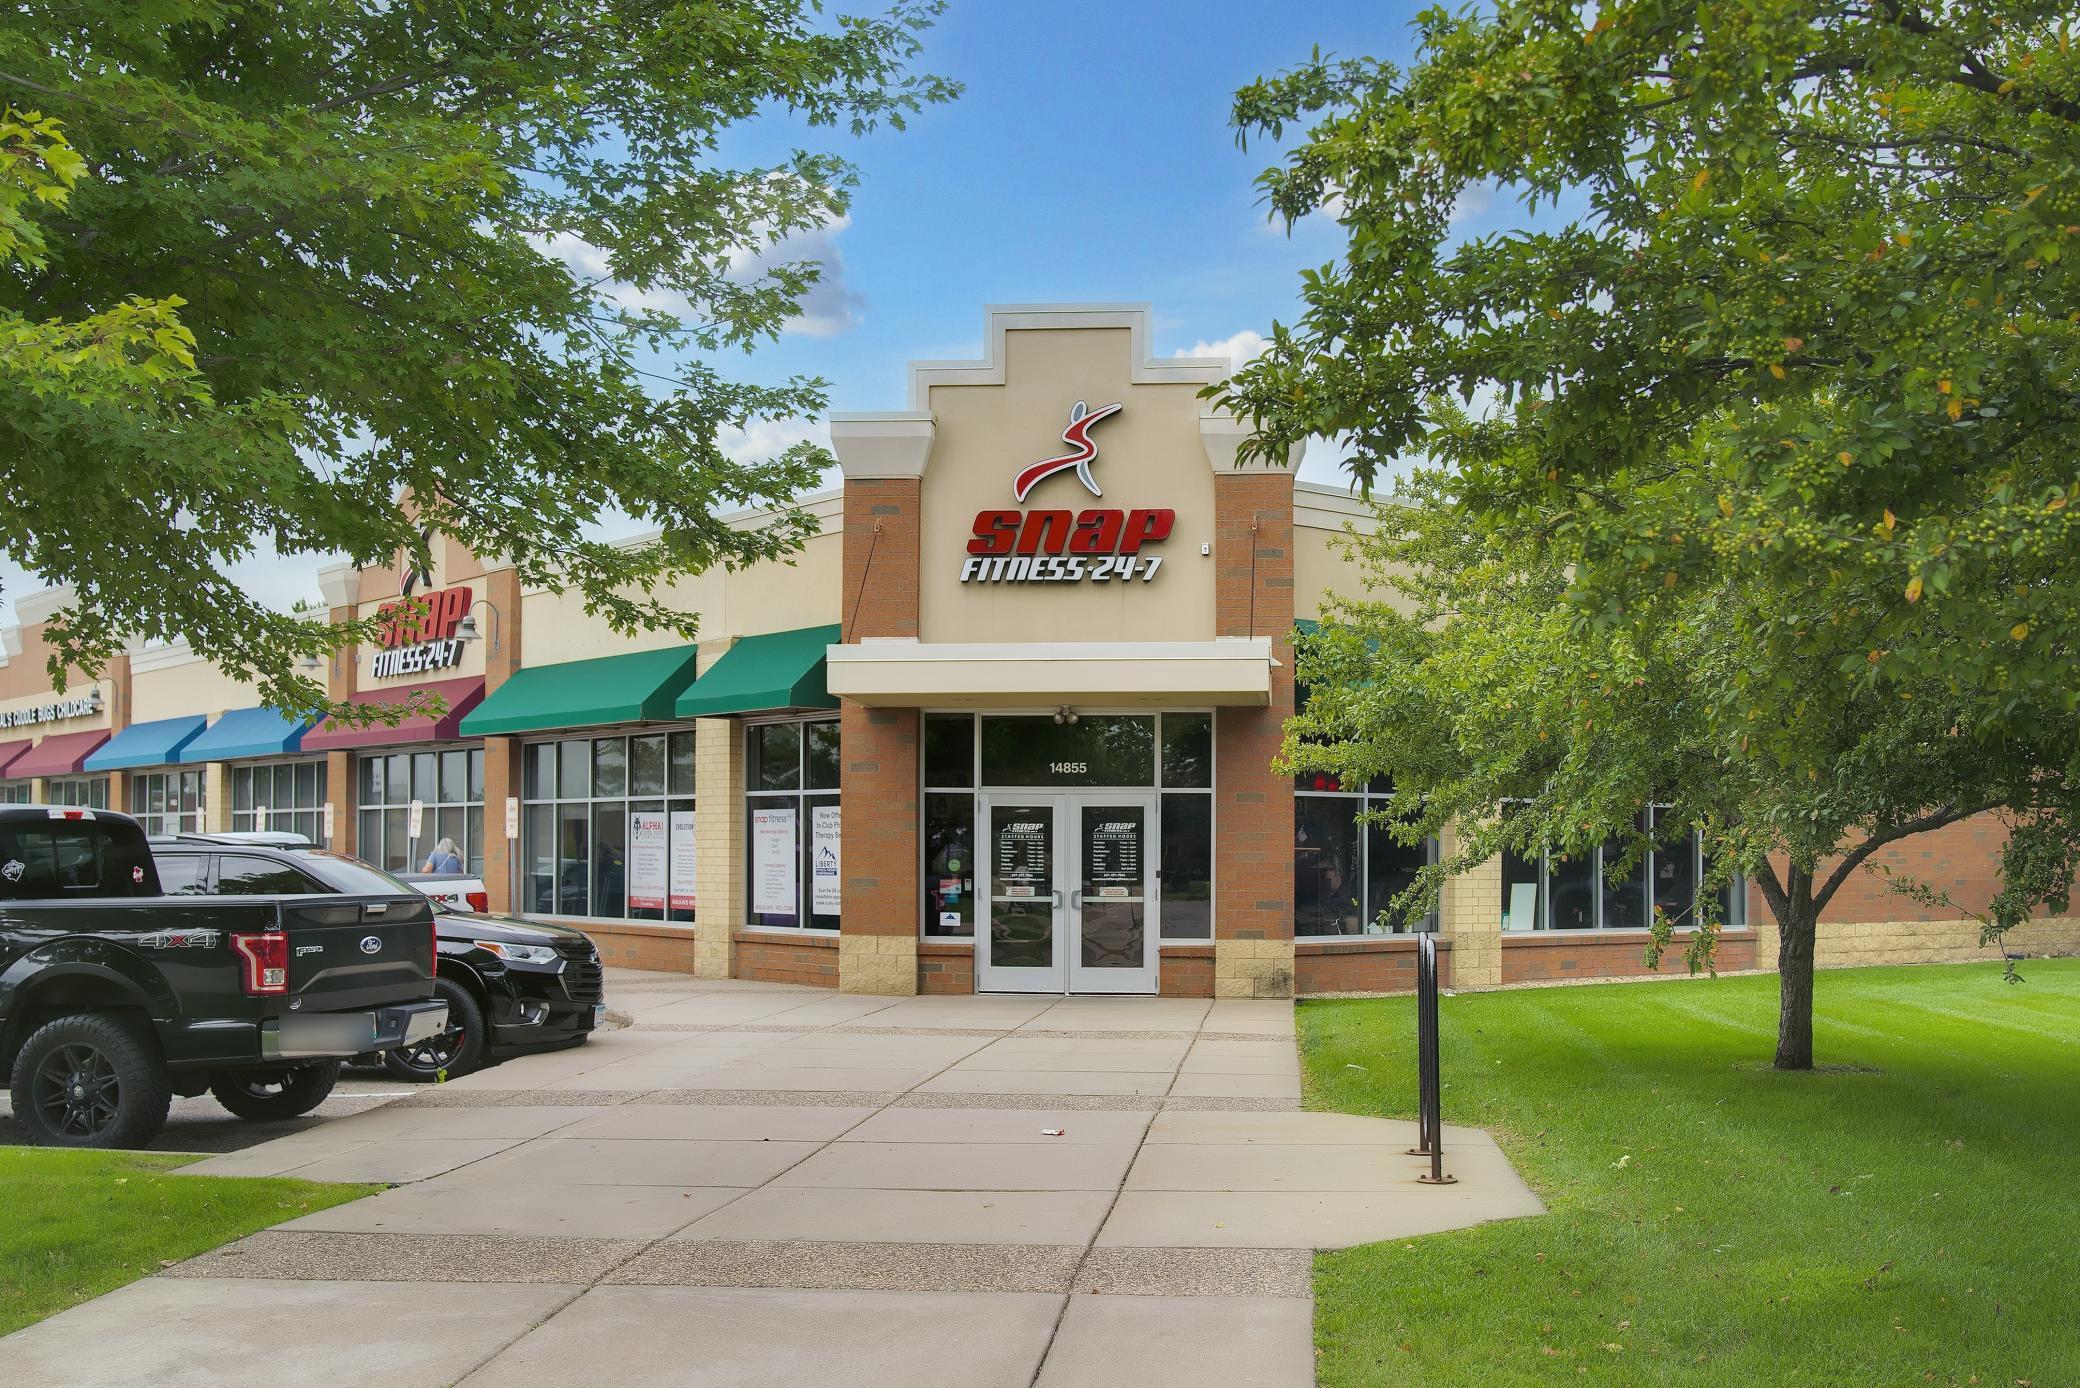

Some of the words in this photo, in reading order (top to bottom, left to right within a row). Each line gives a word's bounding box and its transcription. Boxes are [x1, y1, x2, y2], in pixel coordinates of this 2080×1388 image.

[38, 704, 56, 723] BUGS
[1049, 762, 1087, 774] 14855
[754, 816, 768, 825] snap
[768, 814, 787, 823] fitness
[816, 821, 833, 829] In-Club
[815, 831, 834, 840] Therapy
[815, 860, 837, 868] LIBERTY
